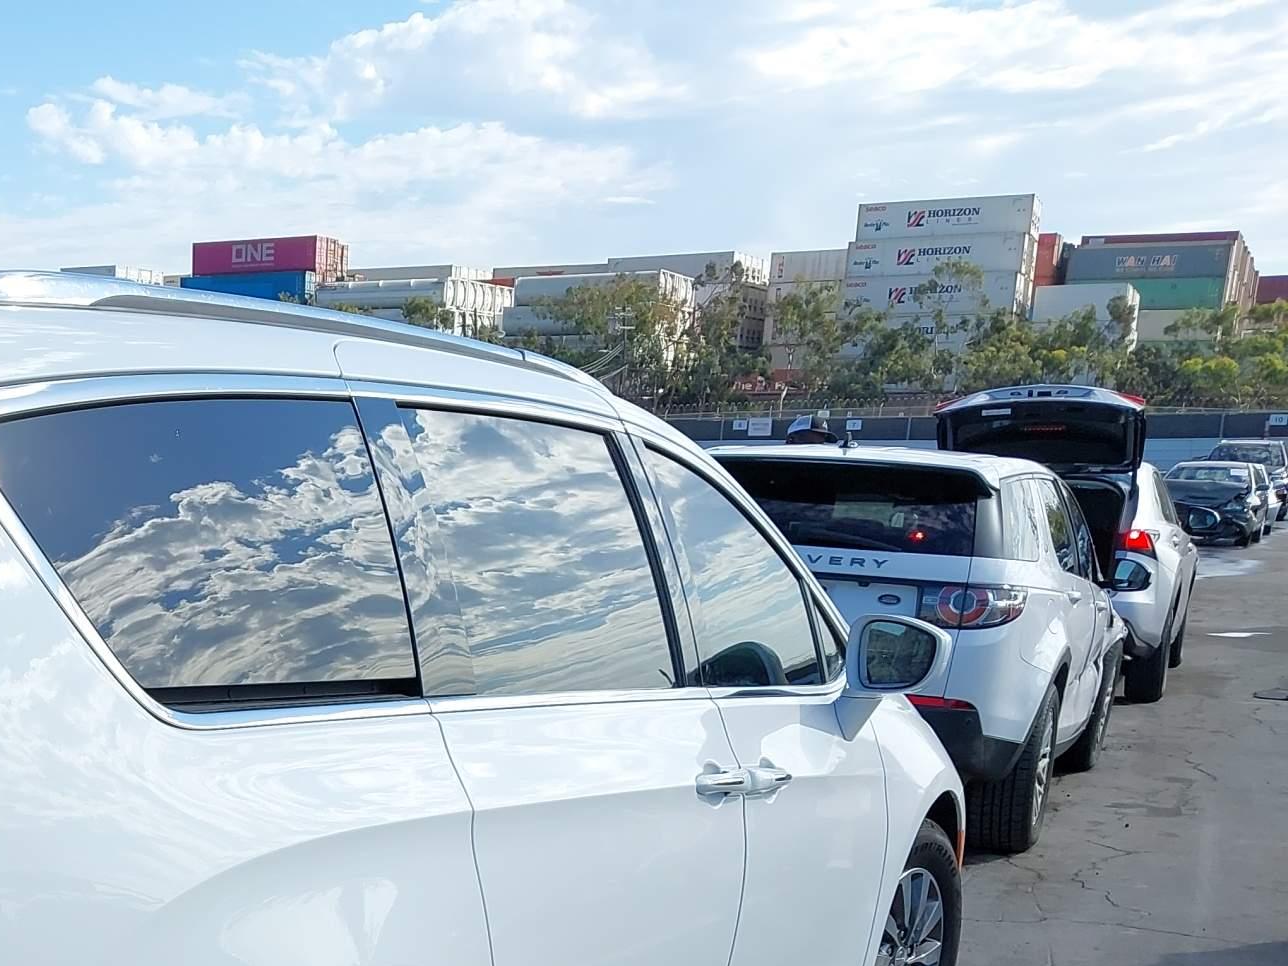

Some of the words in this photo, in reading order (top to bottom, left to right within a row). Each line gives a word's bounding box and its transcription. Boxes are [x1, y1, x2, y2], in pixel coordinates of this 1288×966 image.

[927, 207, 981, 218] HORIZON
[232, 243, 275, 263] ONE
[918, 246, 971, 256] HORIZON
[1115, 255, 1146, 267] WAN
[909, 283, 962, 295] HIZON
